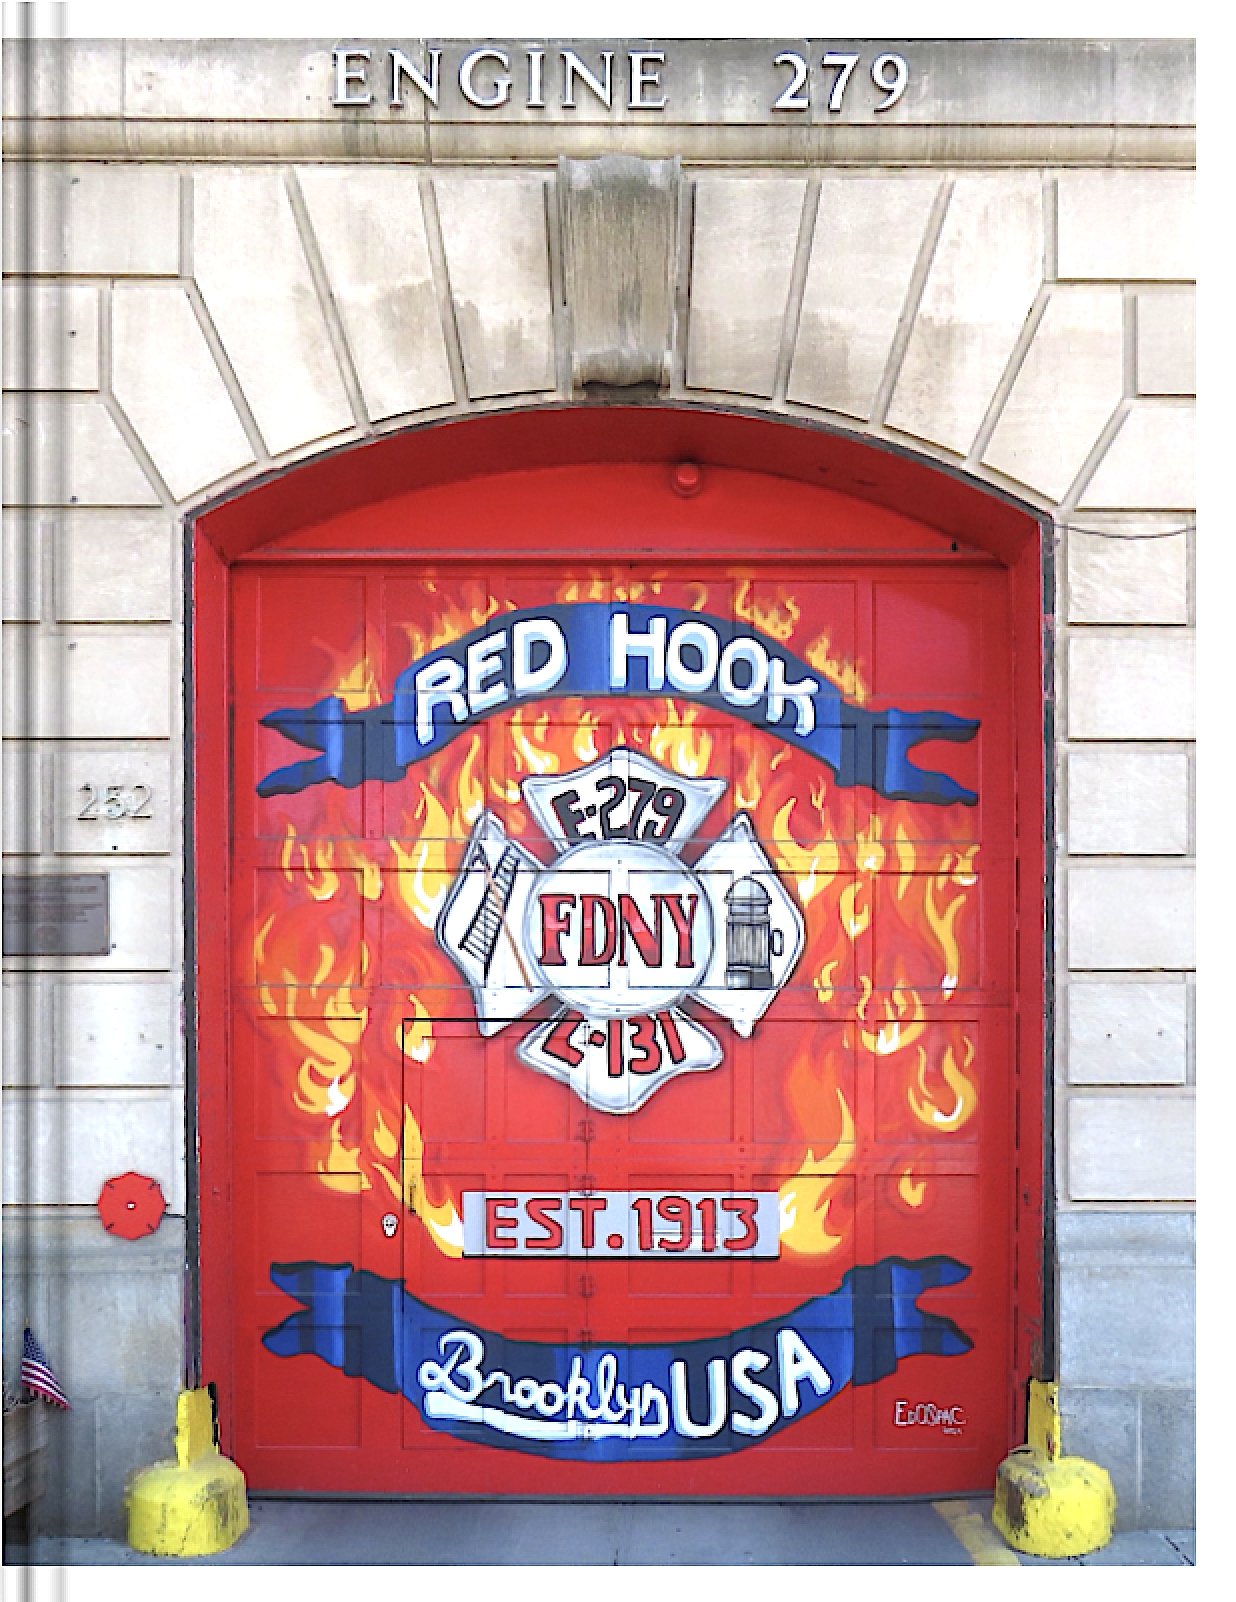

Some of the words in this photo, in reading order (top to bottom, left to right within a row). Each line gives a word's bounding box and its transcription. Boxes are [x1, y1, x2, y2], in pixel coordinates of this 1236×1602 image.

[332, 49, 669, 110] ENGINE
[771, 52, 910, 112] 279
[414, 616, 569, 746] RED
[608, 611, 820, 738] HOOK
[551, 776, 686, 845] E-279
[538, 893, 698, 969] FDNY
[541, 1010, 687, 1078] L-131
[417, 1329, 670, 1440] Brooklyn
[669, 1327, 834, 1438] USA
